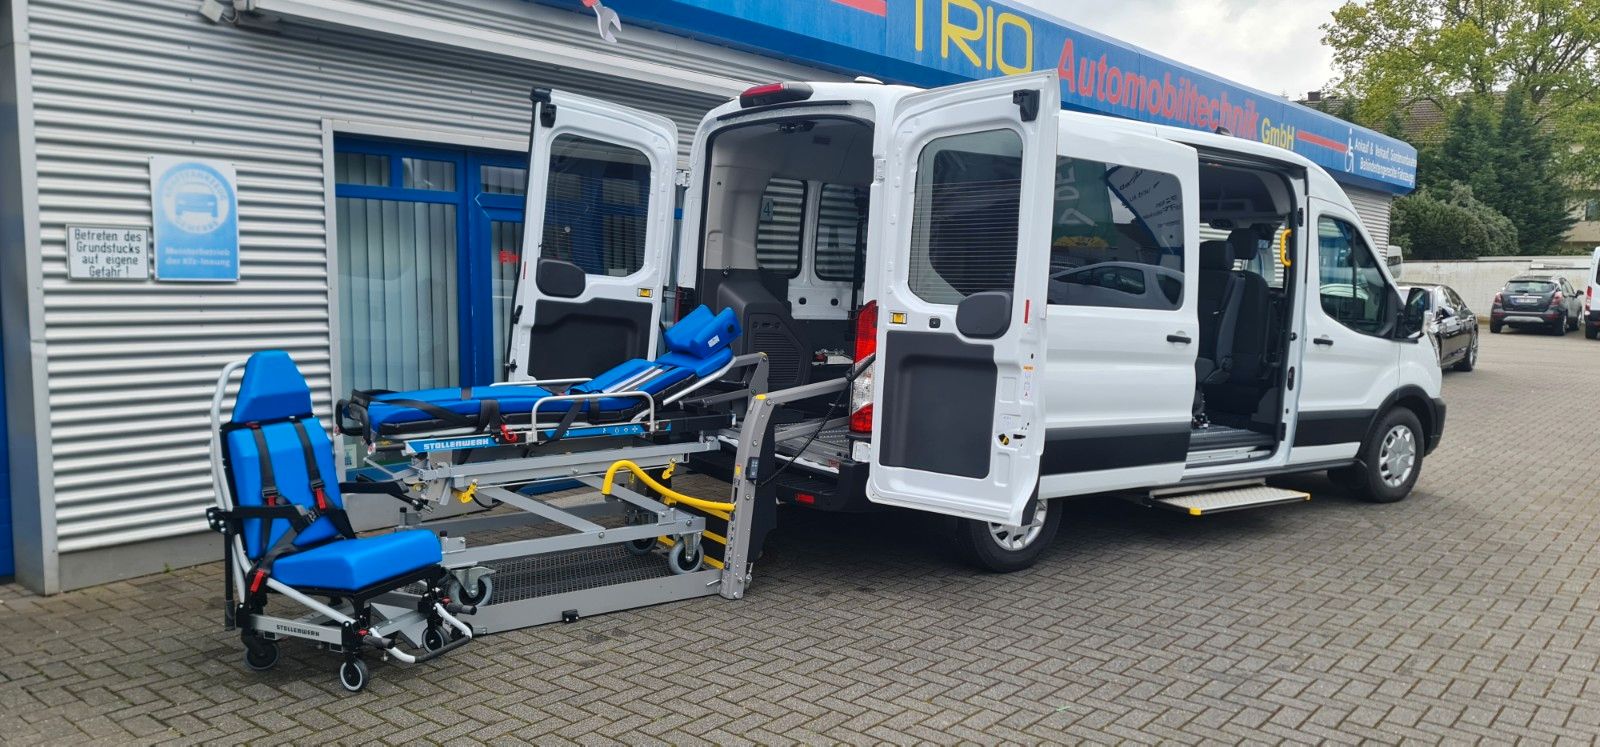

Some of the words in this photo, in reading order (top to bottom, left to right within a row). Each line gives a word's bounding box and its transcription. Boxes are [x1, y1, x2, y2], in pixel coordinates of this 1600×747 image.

[915, 0, 1033, 75] TRIO
[1057, 38, 1260, 141] Automobiltechnik
[1261, 117, 1295, 151] GmbH
[74, 228, 118, 241] Betreten
[124, 230, 142, 242] des
[82, 253, 99, 264] auf
[105, 256, 139, 267] eigene
[89, 265, 122, 277] Gefahr
[423, 438, 489, 450] STOLLENWERK
[276, 625, 320, 637] STOLLENWERK
